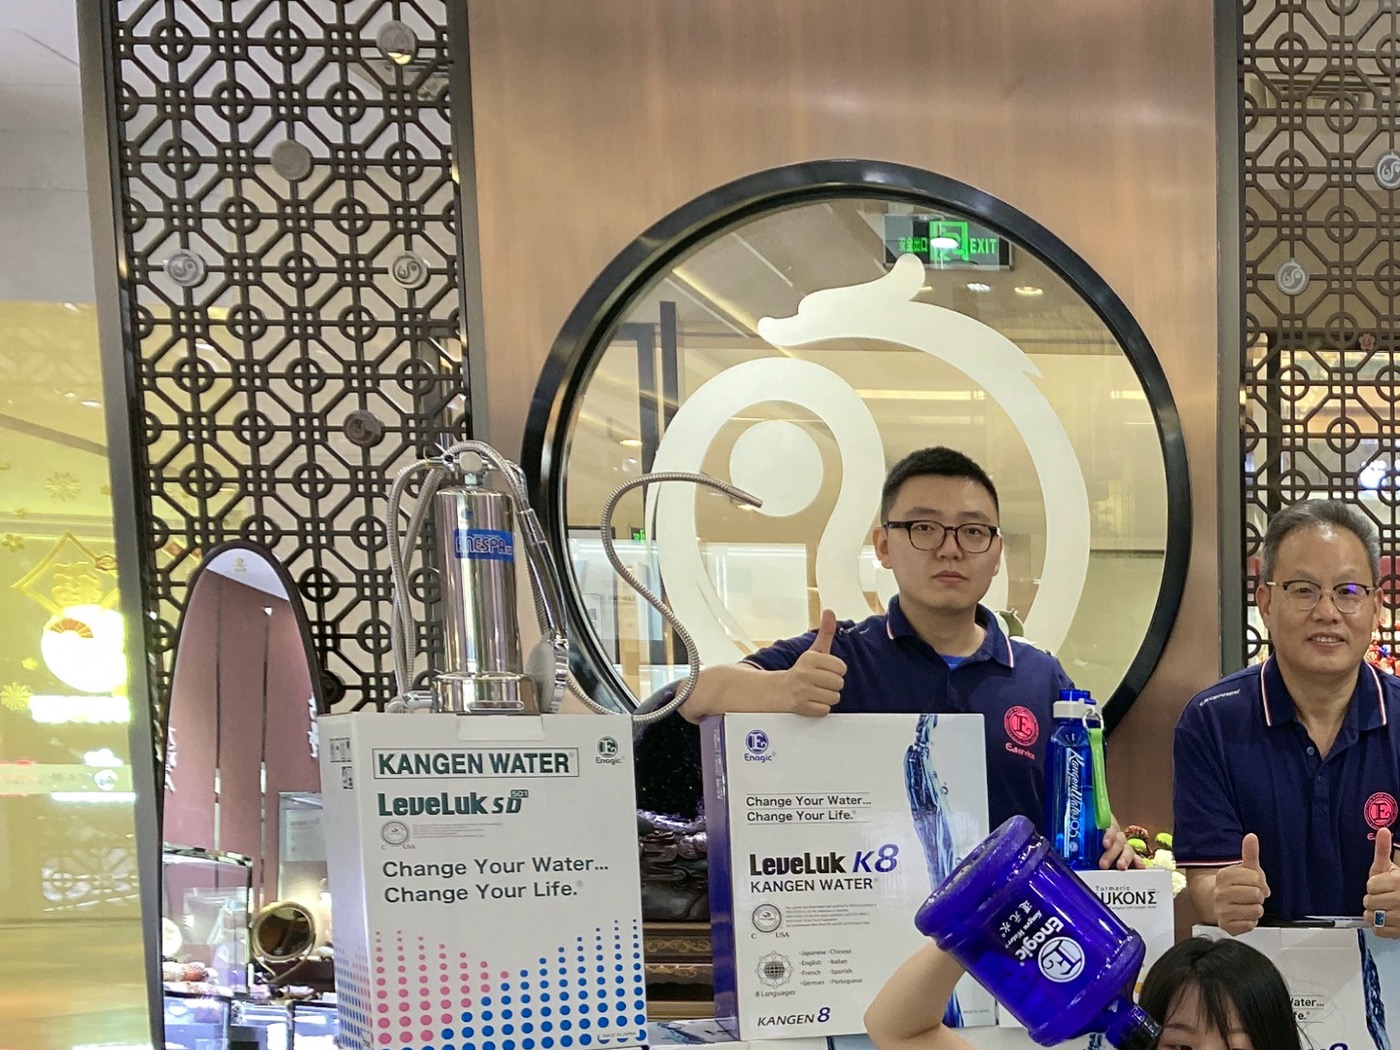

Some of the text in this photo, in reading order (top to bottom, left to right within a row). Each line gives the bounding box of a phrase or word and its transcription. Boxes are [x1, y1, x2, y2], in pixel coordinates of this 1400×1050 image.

[970, 238, 996, 254] EXIT
[378, 752, 569, 775] KANGEN WATER
[745, 753, 772, 763] Enagic
[378, 792, 488, 816] LeveLuk
[383, 861, 466, 877] Change
[474, 859, 525, 874] Your
[750, 844, 899, 875] LeveLuk K8
[385, 887, 468, 903] Change
[475, 884, 526, 899] Your
[751, 878, 873, 893] KANGEN WATER
[1015, 917, 1064, 960] Enagic
[757, 1007, 830, 1026] KANGEN 8
